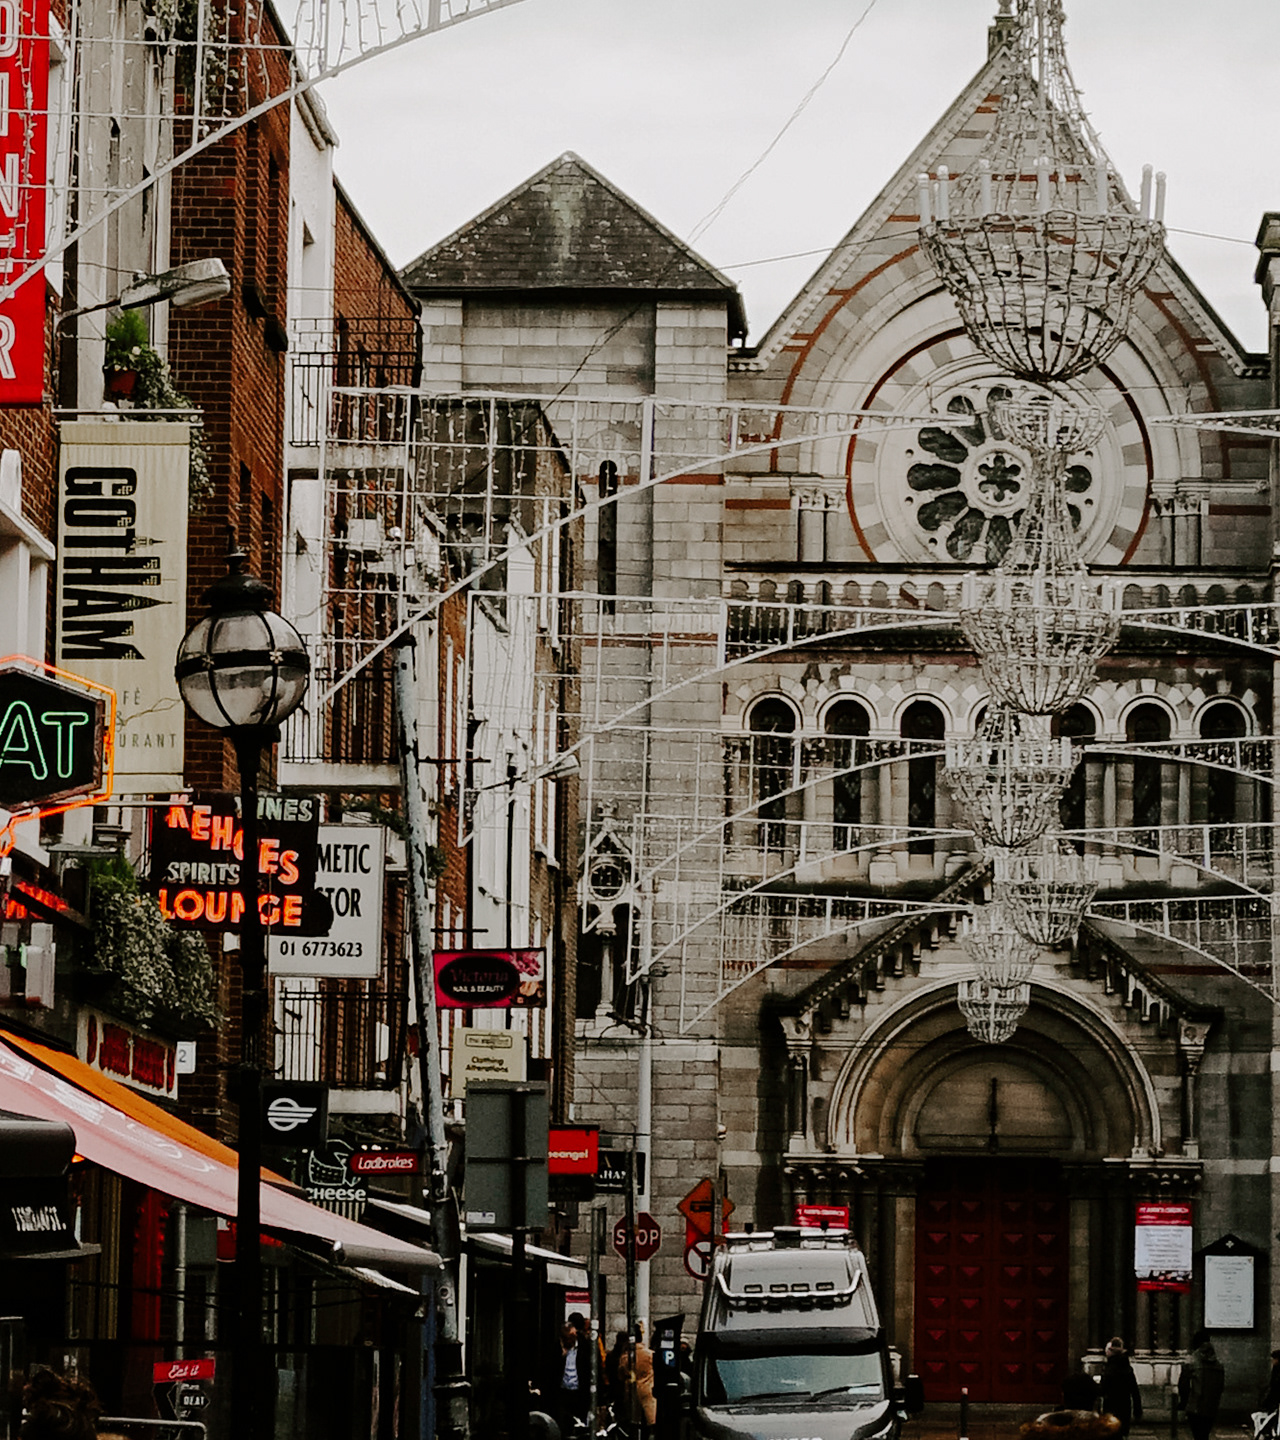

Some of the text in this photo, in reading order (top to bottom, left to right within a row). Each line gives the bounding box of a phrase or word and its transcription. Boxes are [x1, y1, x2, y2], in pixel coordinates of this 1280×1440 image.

[61, 466, 172, 661] GOTHAM
[119, 733, 177, 749] URANT
[317, 843, 372, 875] METIC
[162, 860, 242, 886] SPIRITS
[158, 888, 304, 928] LOUNGE
[280, 940, 363, 958] 01 6773623
[357, 1154, 414, 1172] Ladbrokes
[615, 1230, 659, 1246] SOP
